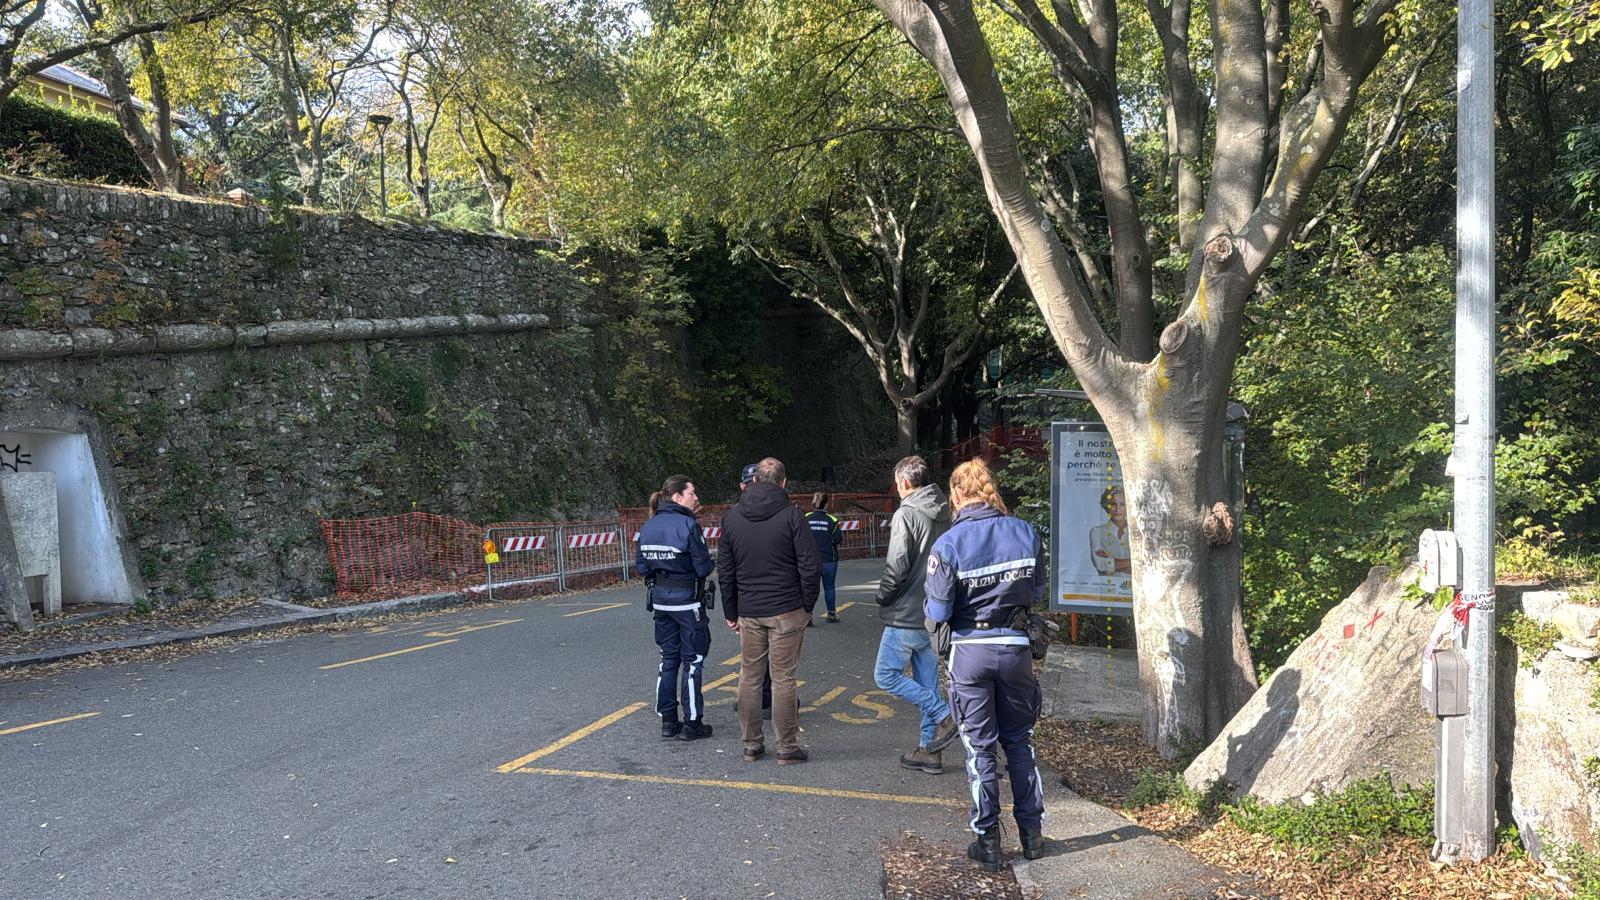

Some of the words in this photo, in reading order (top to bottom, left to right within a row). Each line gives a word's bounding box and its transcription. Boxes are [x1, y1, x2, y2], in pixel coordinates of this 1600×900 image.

[1087, 440, 1114, 448] nostr
[1084, 450, 1112, 458] molto
[962, 575, 996, 588] POLIZIA
[999, 569, 1032, 583] LOCALE
